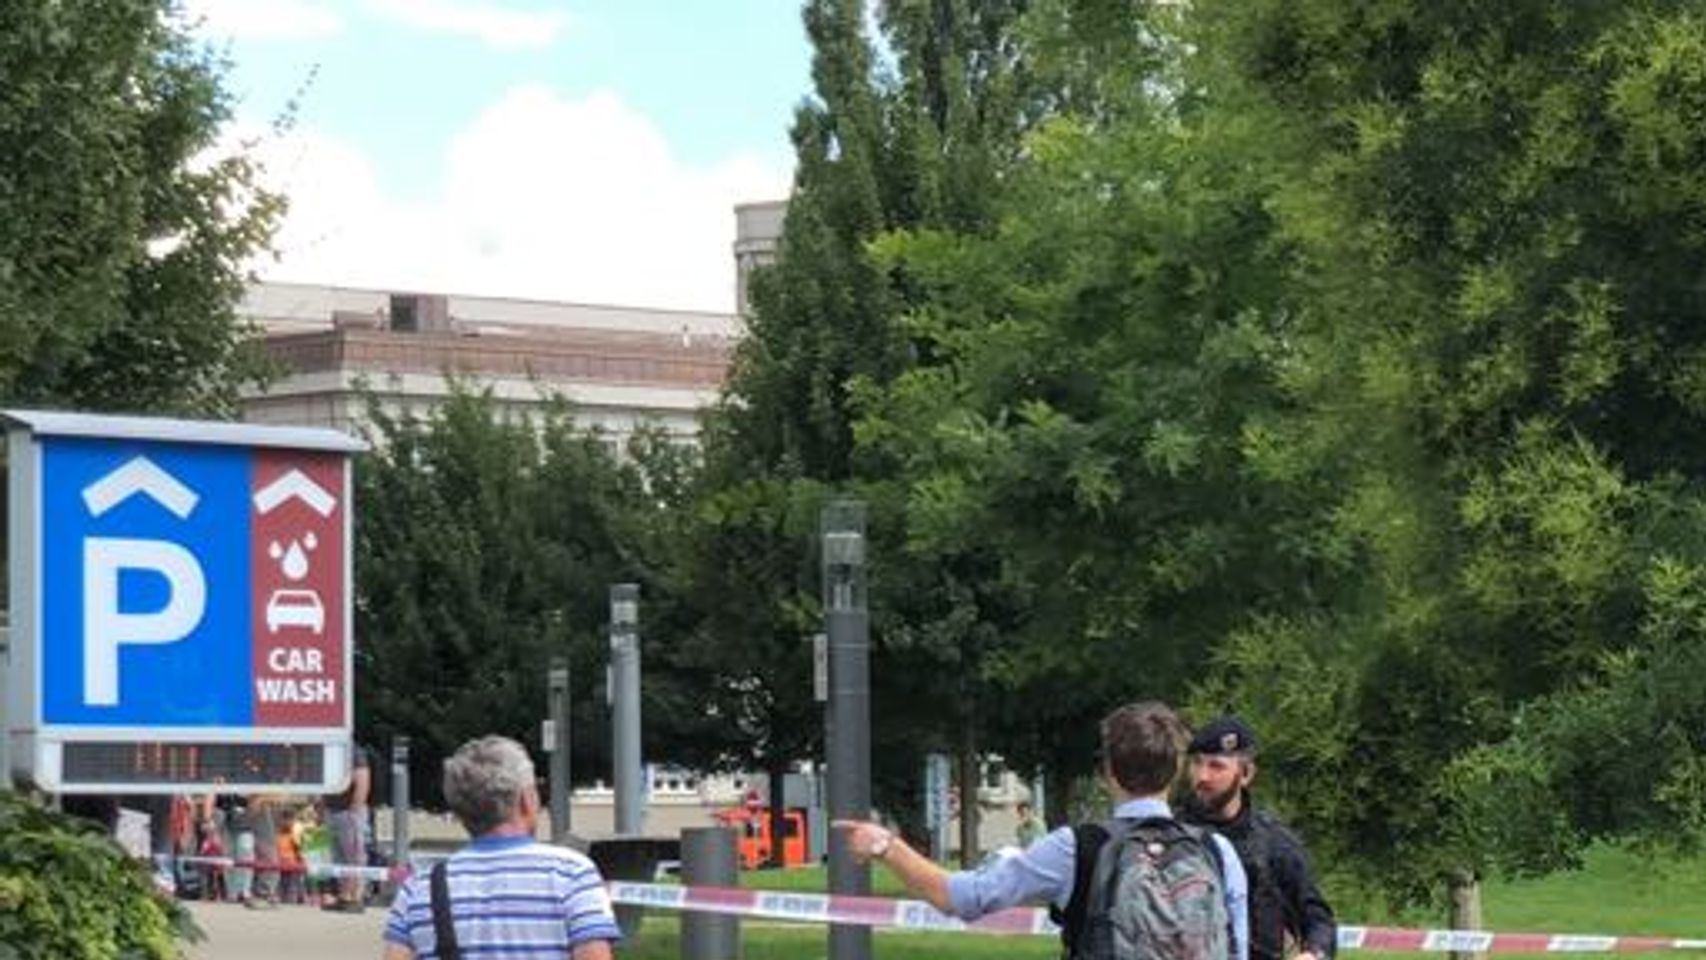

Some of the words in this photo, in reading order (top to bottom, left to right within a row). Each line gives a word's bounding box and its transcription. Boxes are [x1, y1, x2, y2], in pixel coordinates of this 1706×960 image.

[83, 536, 207, 706] P
[268, 647, 323, 672] CAR
[257, 679, 335, 702] WASH
